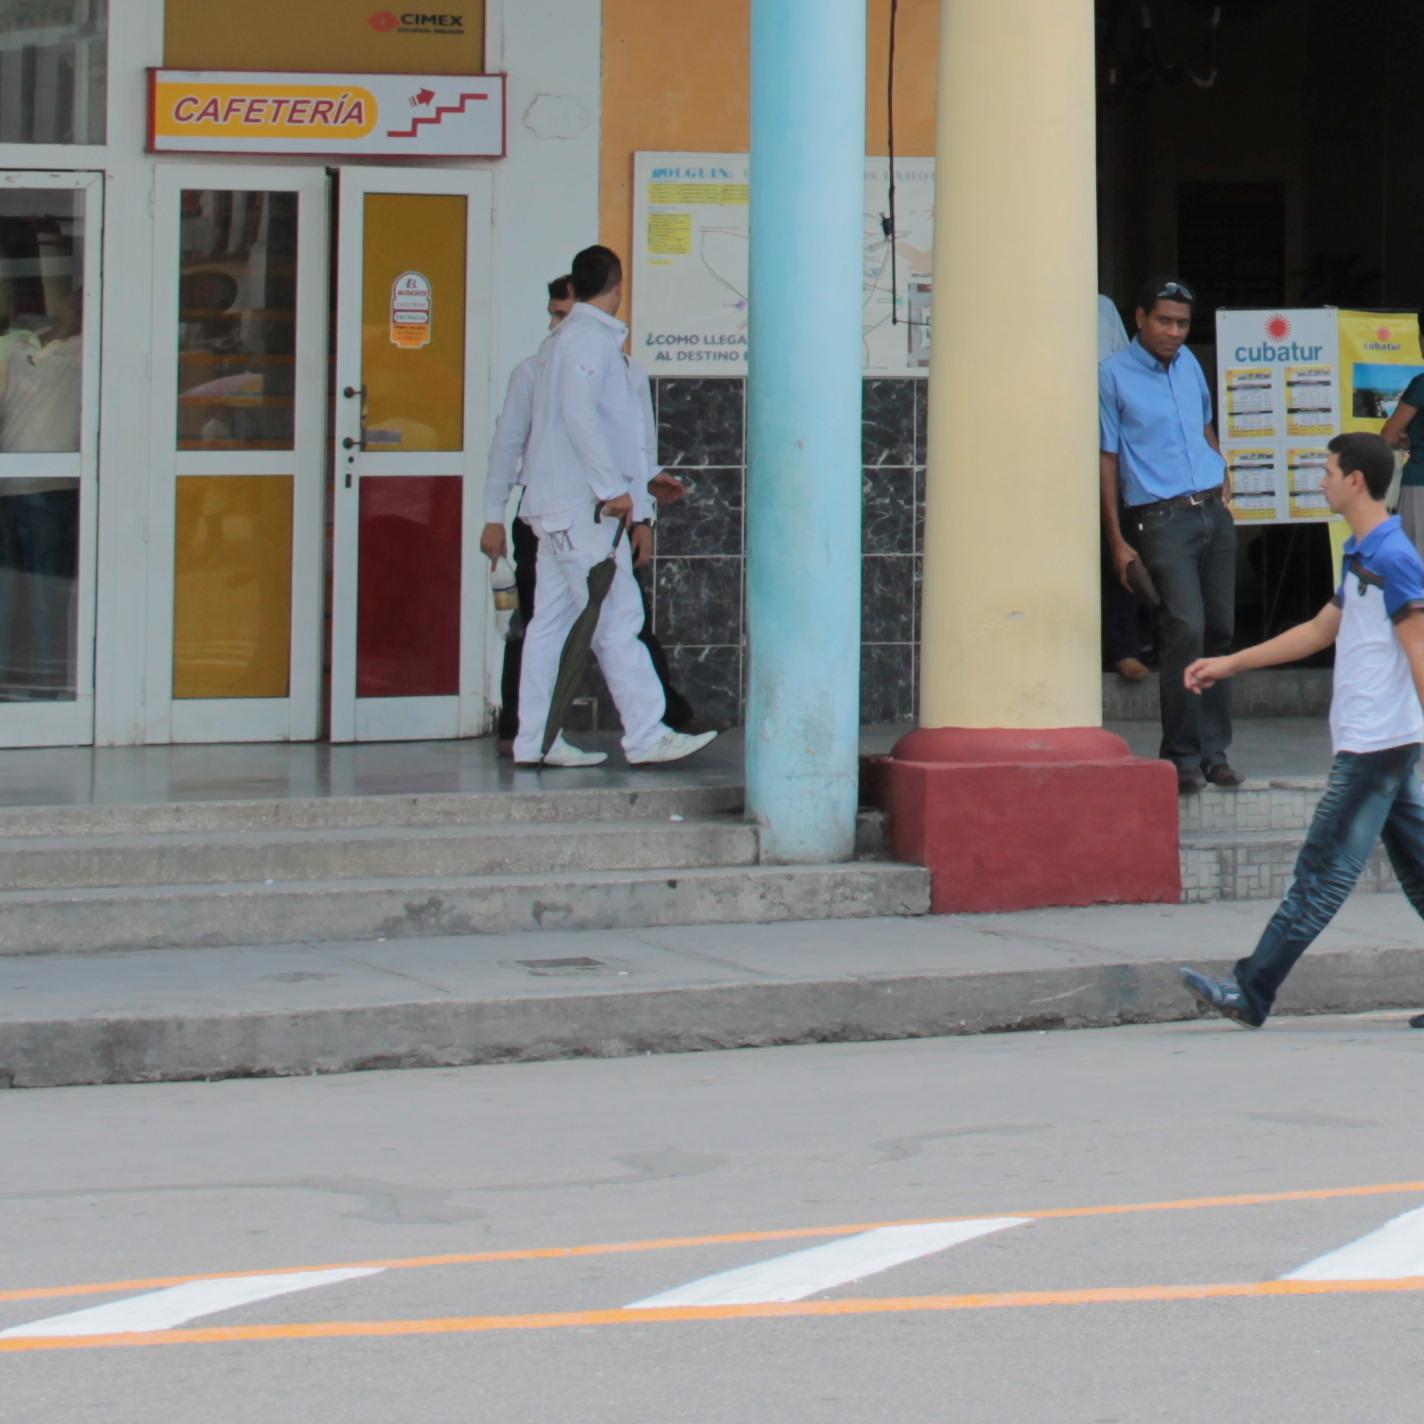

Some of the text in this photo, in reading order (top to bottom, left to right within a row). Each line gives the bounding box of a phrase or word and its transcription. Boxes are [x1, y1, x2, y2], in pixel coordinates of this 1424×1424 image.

[400, 12, 463, 27] CIMEX
[173, 93, 365, 125] CAFETERÍA
[645, 332, 749, 346] ¿COMO LLEGA
[655, 350, 672, 361] AL
[677, 350, 740, 361] DESTINO
[1234, 340, 1323, 362] cubatur
